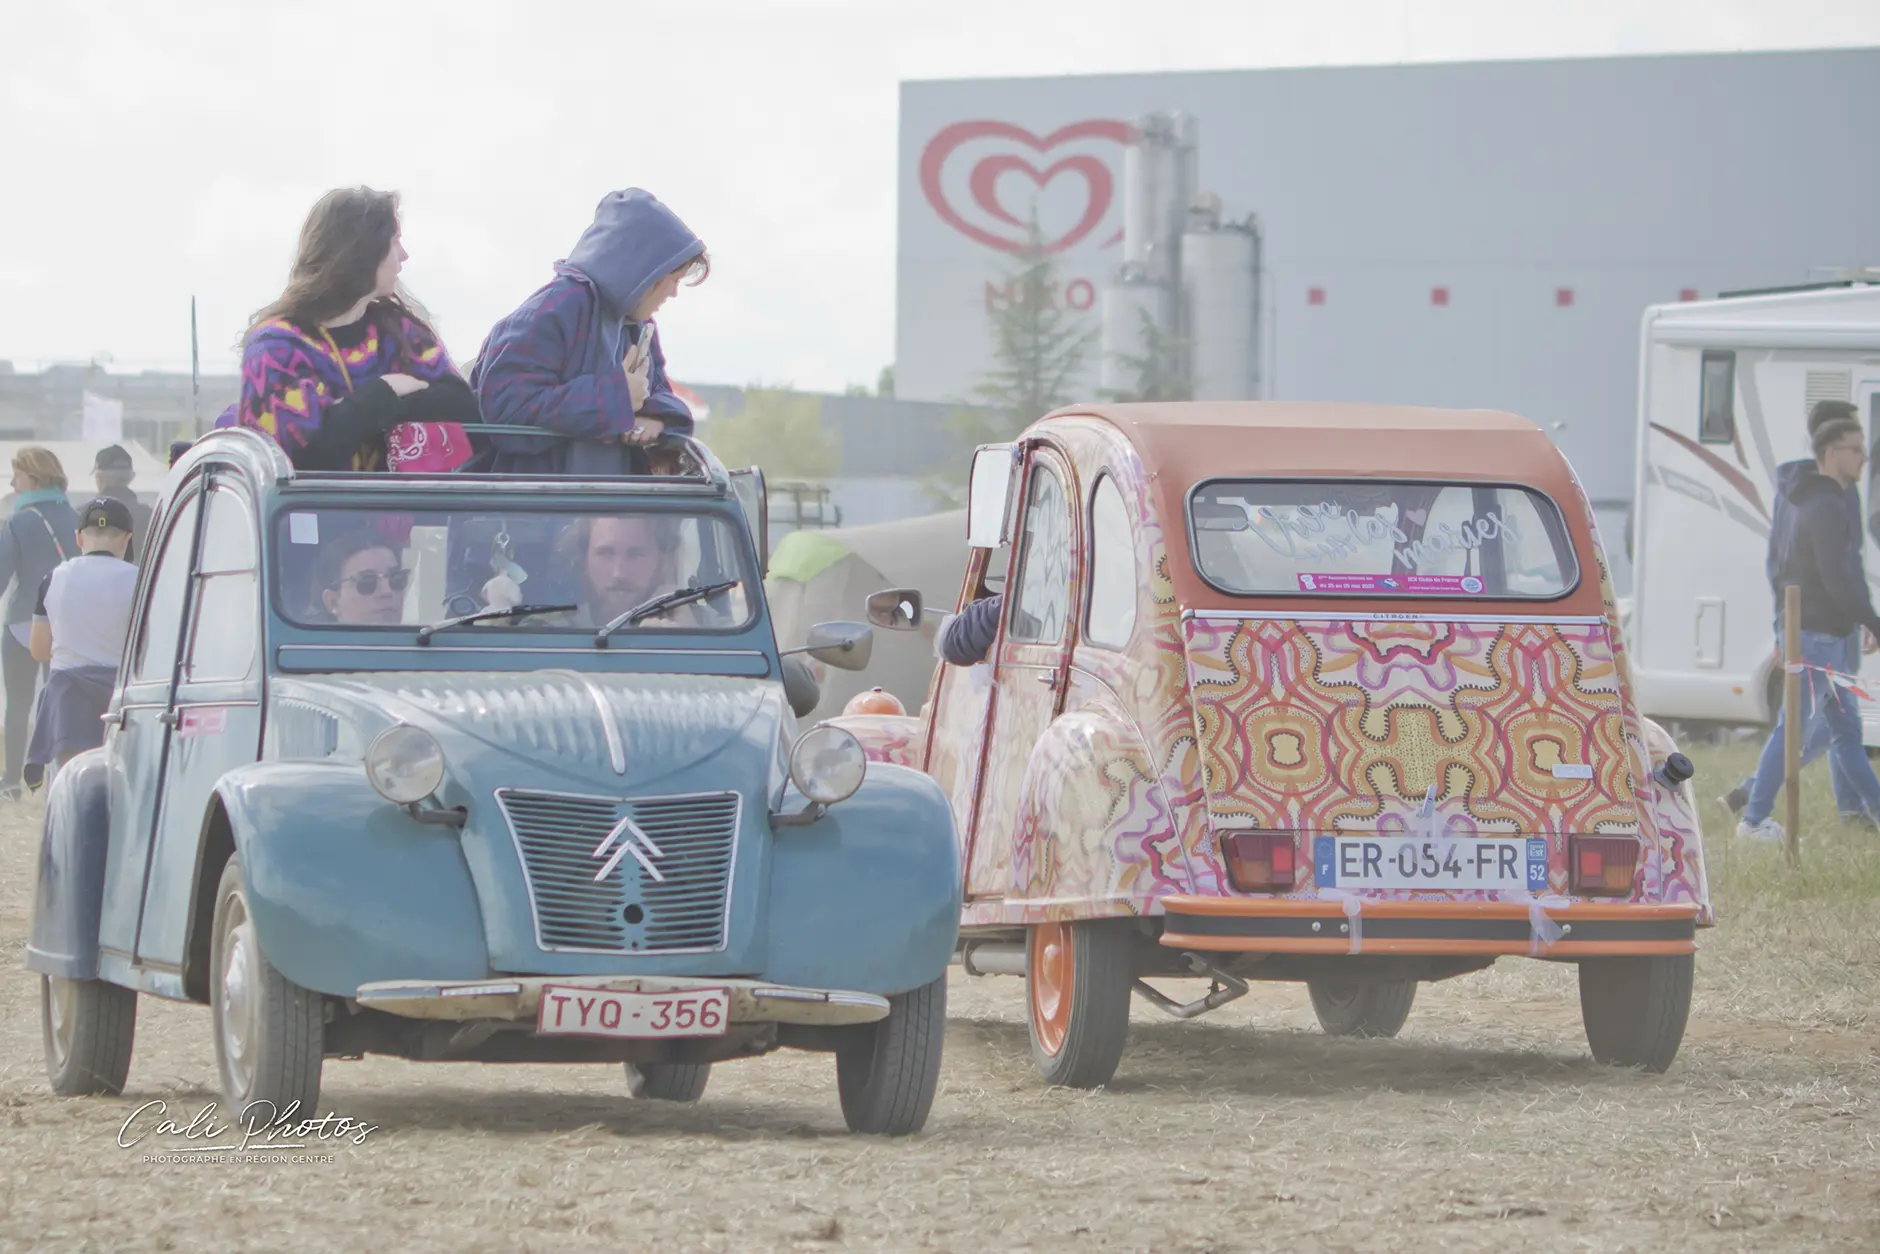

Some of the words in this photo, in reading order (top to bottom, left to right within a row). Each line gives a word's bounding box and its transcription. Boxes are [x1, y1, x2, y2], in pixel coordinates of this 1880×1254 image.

[1322, 863, 1329, 875] F
[1340, 842, 1518, 879] ER-054-FR
[1530, 864, 1546, 881] 52
